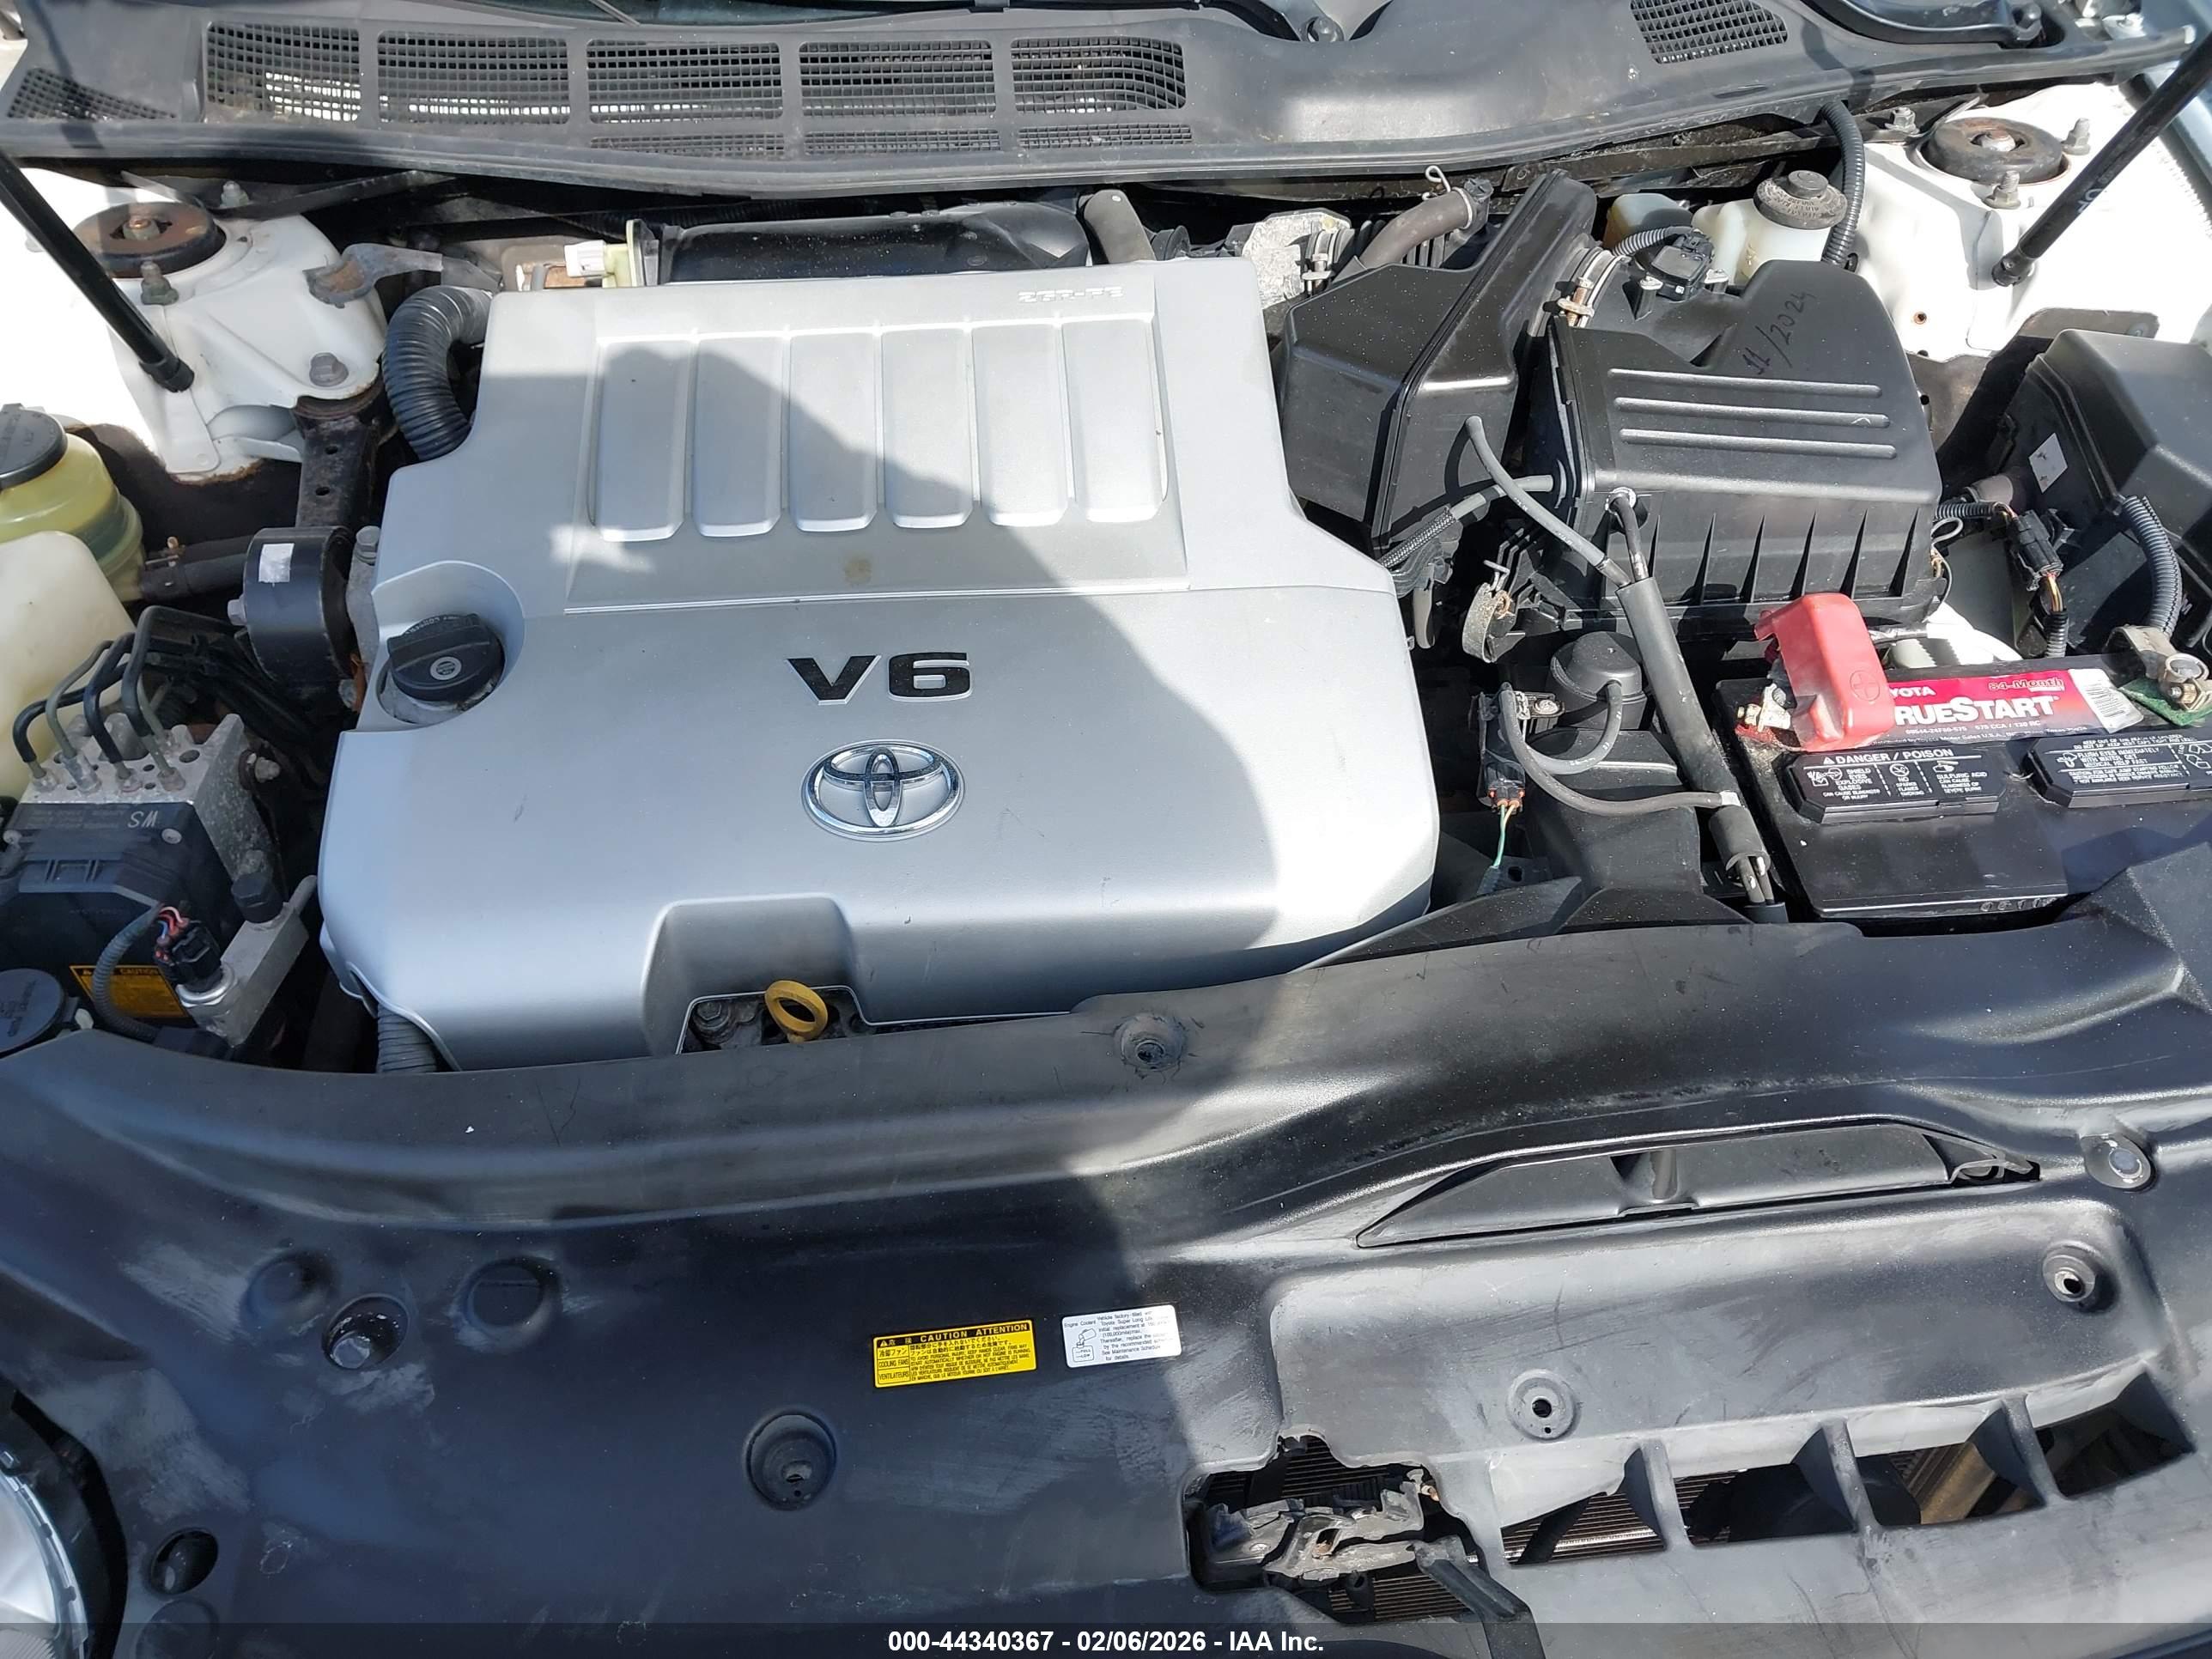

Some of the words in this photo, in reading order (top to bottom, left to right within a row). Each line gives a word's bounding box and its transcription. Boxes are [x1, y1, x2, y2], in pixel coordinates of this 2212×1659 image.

[785, 652, 973, 705] V6
[1889, 685, 1936, 698] YOTA
[1895, 696, 2054, 726] RUESTART
[1836, 753, 1890, 765] DANGER
[1903, 748, 1954, 760] POISON
[921, 1331, 967, 1342] CAUTION
[975, 1323, 1027, 1336] ATTENTION
[879, 1370, 908, 1381] VENTILATEURS
